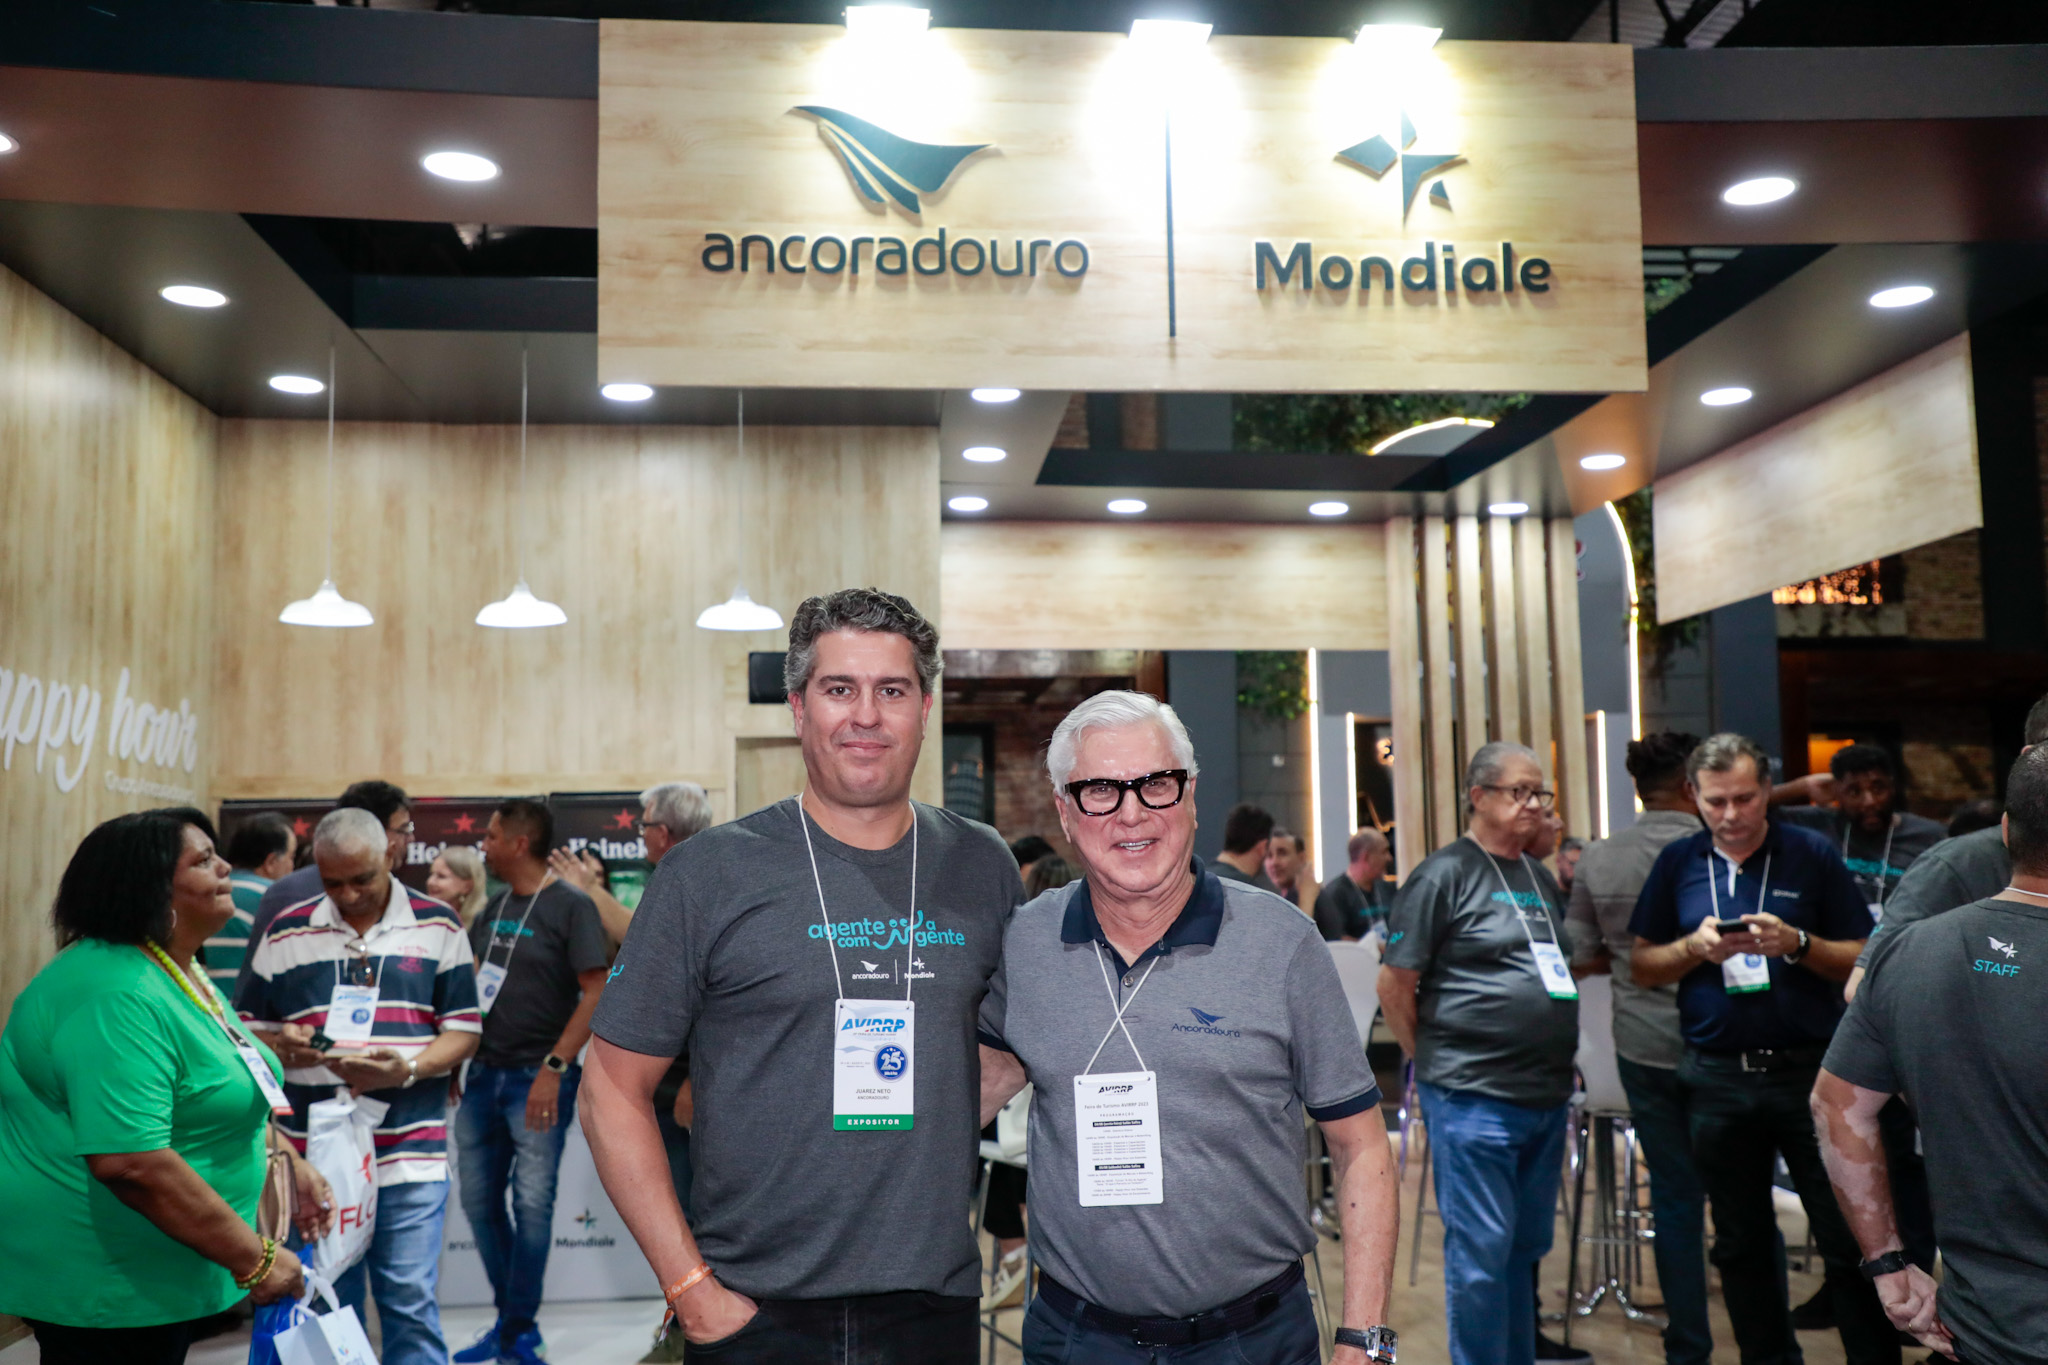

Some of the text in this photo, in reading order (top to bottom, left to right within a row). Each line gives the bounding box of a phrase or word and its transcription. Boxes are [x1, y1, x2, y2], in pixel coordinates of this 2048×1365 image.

[702, 226, 1090, 277] ancoradouro
[1254, 241, 1551, 293] Mondiale
[107, 666, 197, 774] hour
[808, 918, 886, 940] agente
[915, 929, 966, 947] gente
[837, 936, 871, 948] com
[852, 972, 890, 980] ancoradouro
[1973, 959, 2021, 977] STAFF
[841, 1018, 906, 1032] AVIRRP
[847, 1118, 900, 1126] EXPOSITOR
[555, 1236, 616, 1248] Mondiale
